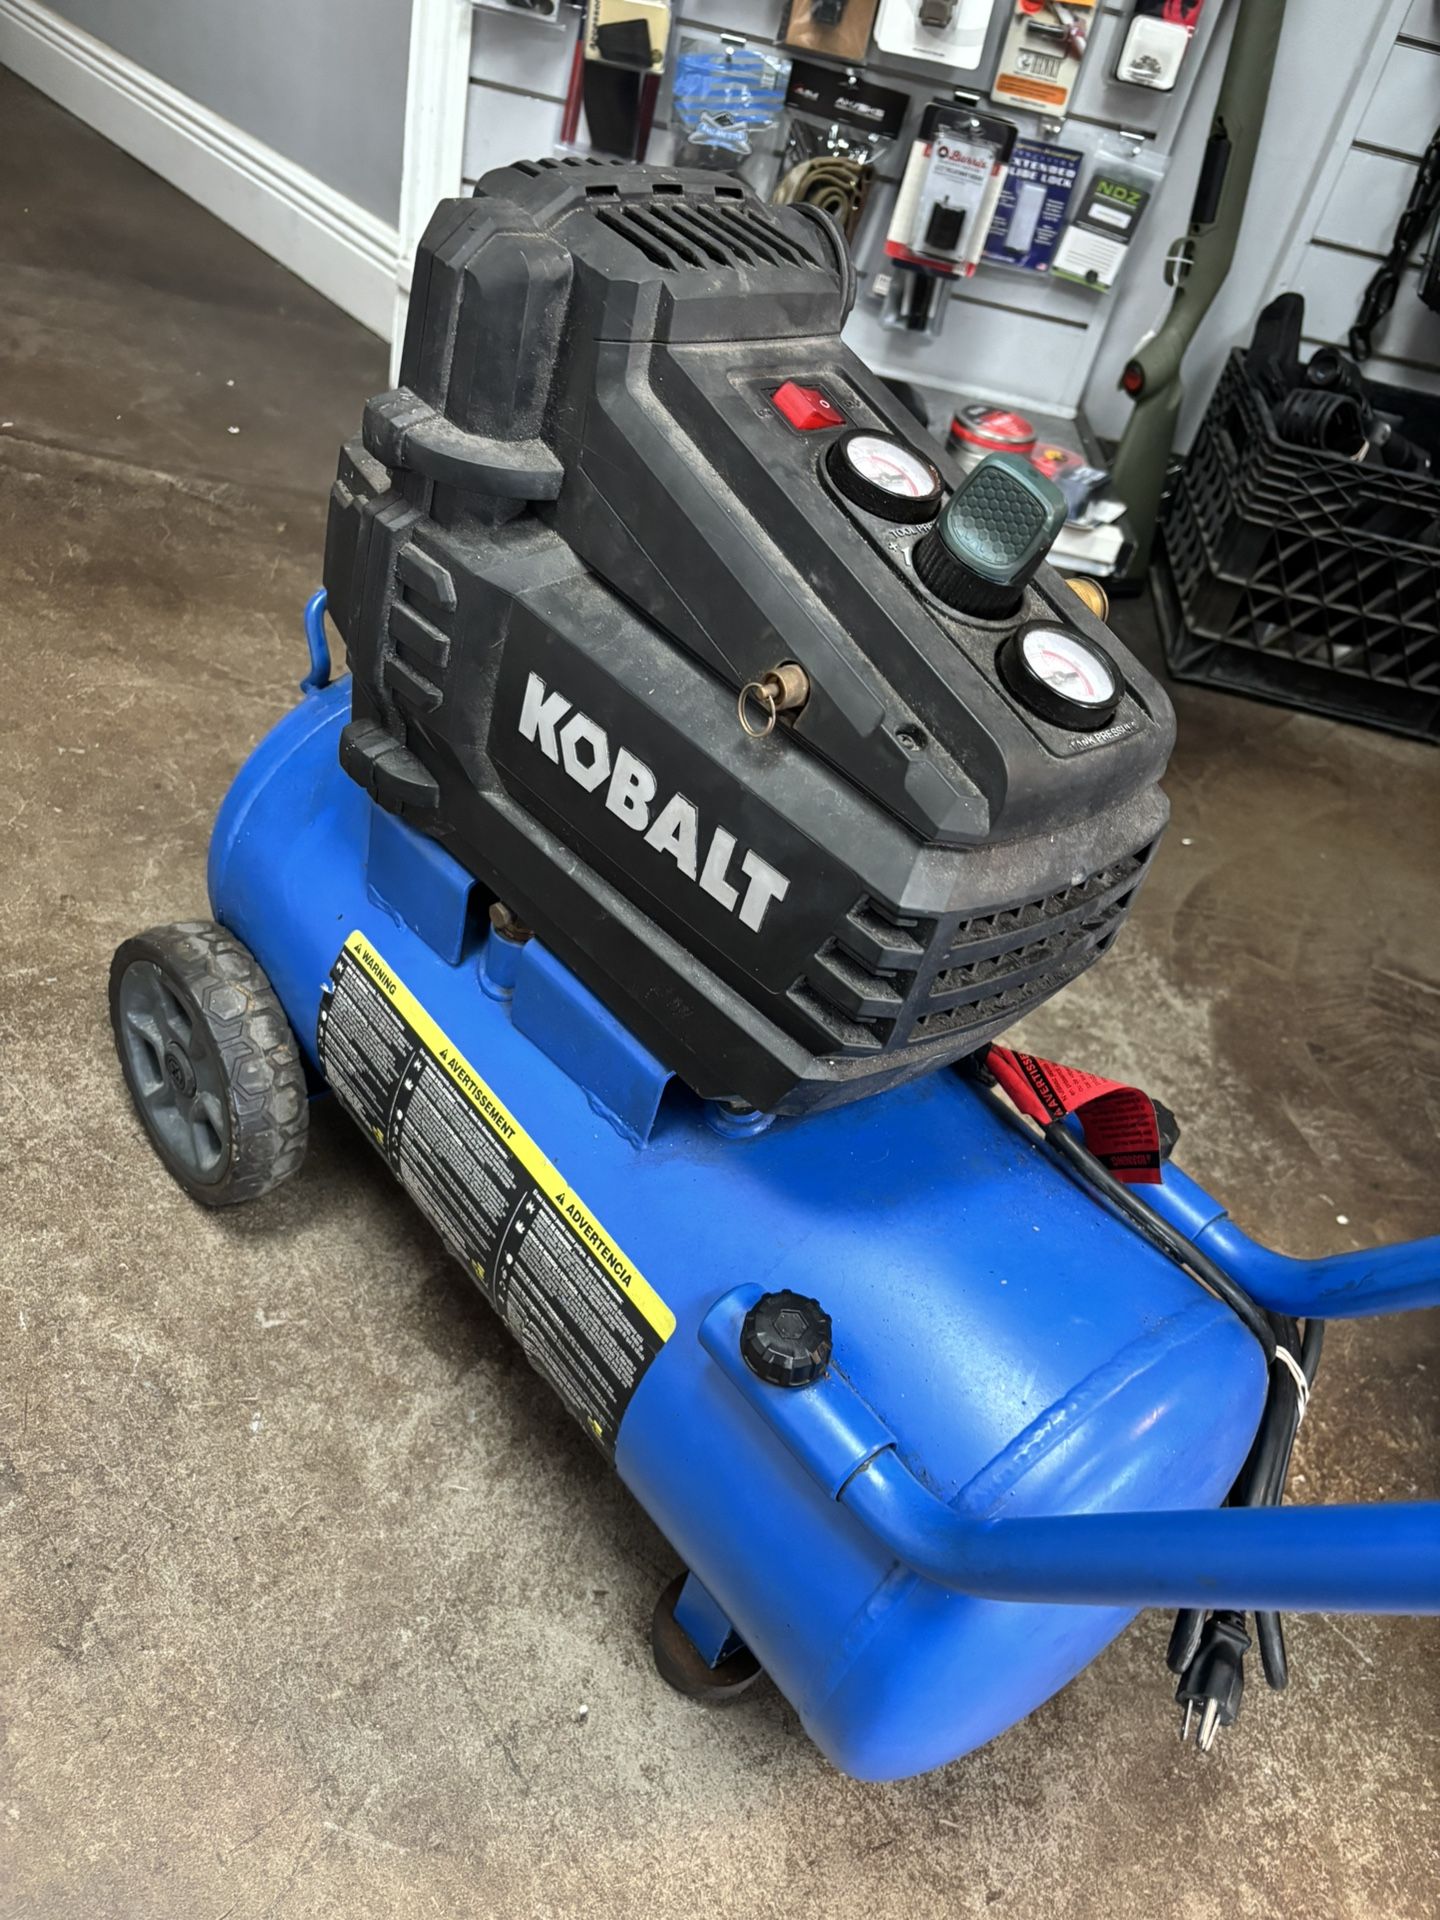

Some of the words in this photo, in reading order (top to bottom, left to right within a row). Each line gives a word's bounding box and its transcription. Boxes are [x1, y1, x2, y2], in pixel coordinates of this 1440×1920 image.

[1009, 166, 1038, 181] LIDE
[1041, 173, 1073, 188] LOCK
[1012, 156, 1076, 179] XTENDED
[1097, 181, 1141, 205] NDZ
[889, 525, 917, 539] TOOL
[1069, 735, 1097, 752] TANK
[518, 671, 791, 934] KOBALT
[362, 950, 397, 996] WARNING
[447, 1057, 516, 1140] AVERTISSEMENT
[566, 1203, 632, 1288] ADVERTENCIA
